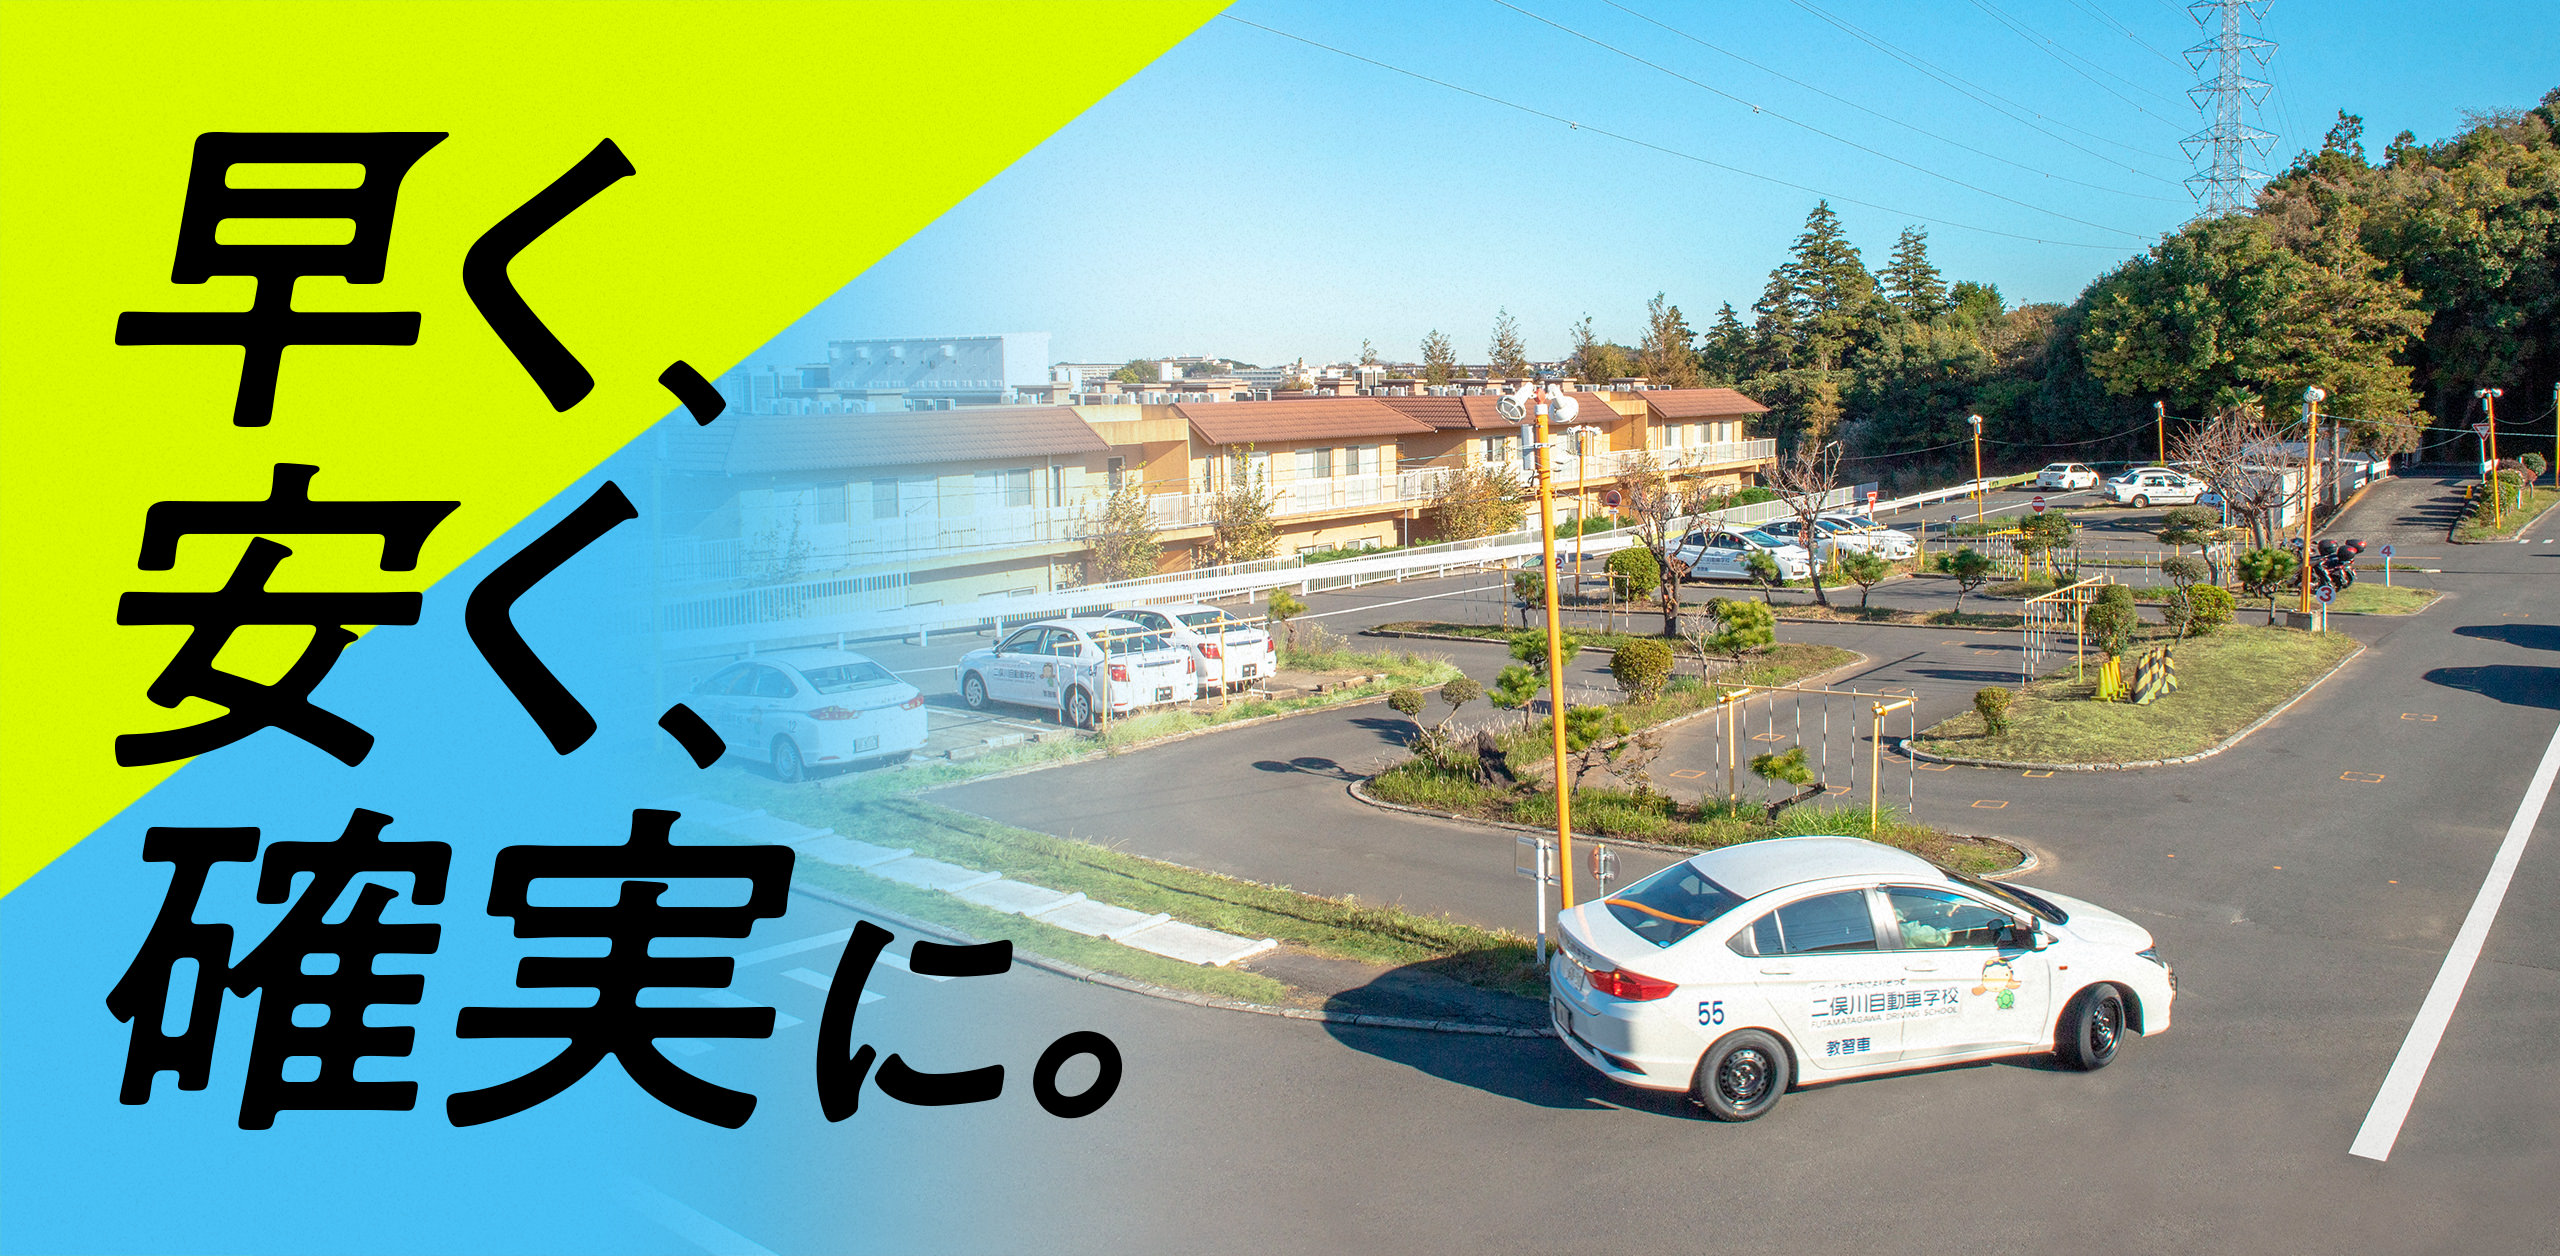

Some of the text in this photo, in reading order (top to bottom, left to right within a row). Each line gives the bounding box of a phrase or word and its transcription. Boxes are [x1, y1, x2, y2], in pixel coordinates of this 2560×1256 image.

[2380, 545, 2392, 557] 4
[2319, 586, 2333, 602] 3
[1810, 986, 1960, 1017] 二俣川自動車学校
[1697, 1000, 1726, 1027] 55
[1885, 1008, 1920, 1021] DRIVING
[1923, 1005, 1958, 1017] SCHOOL
[1825, 1036, 1872, 1057] 教習車
